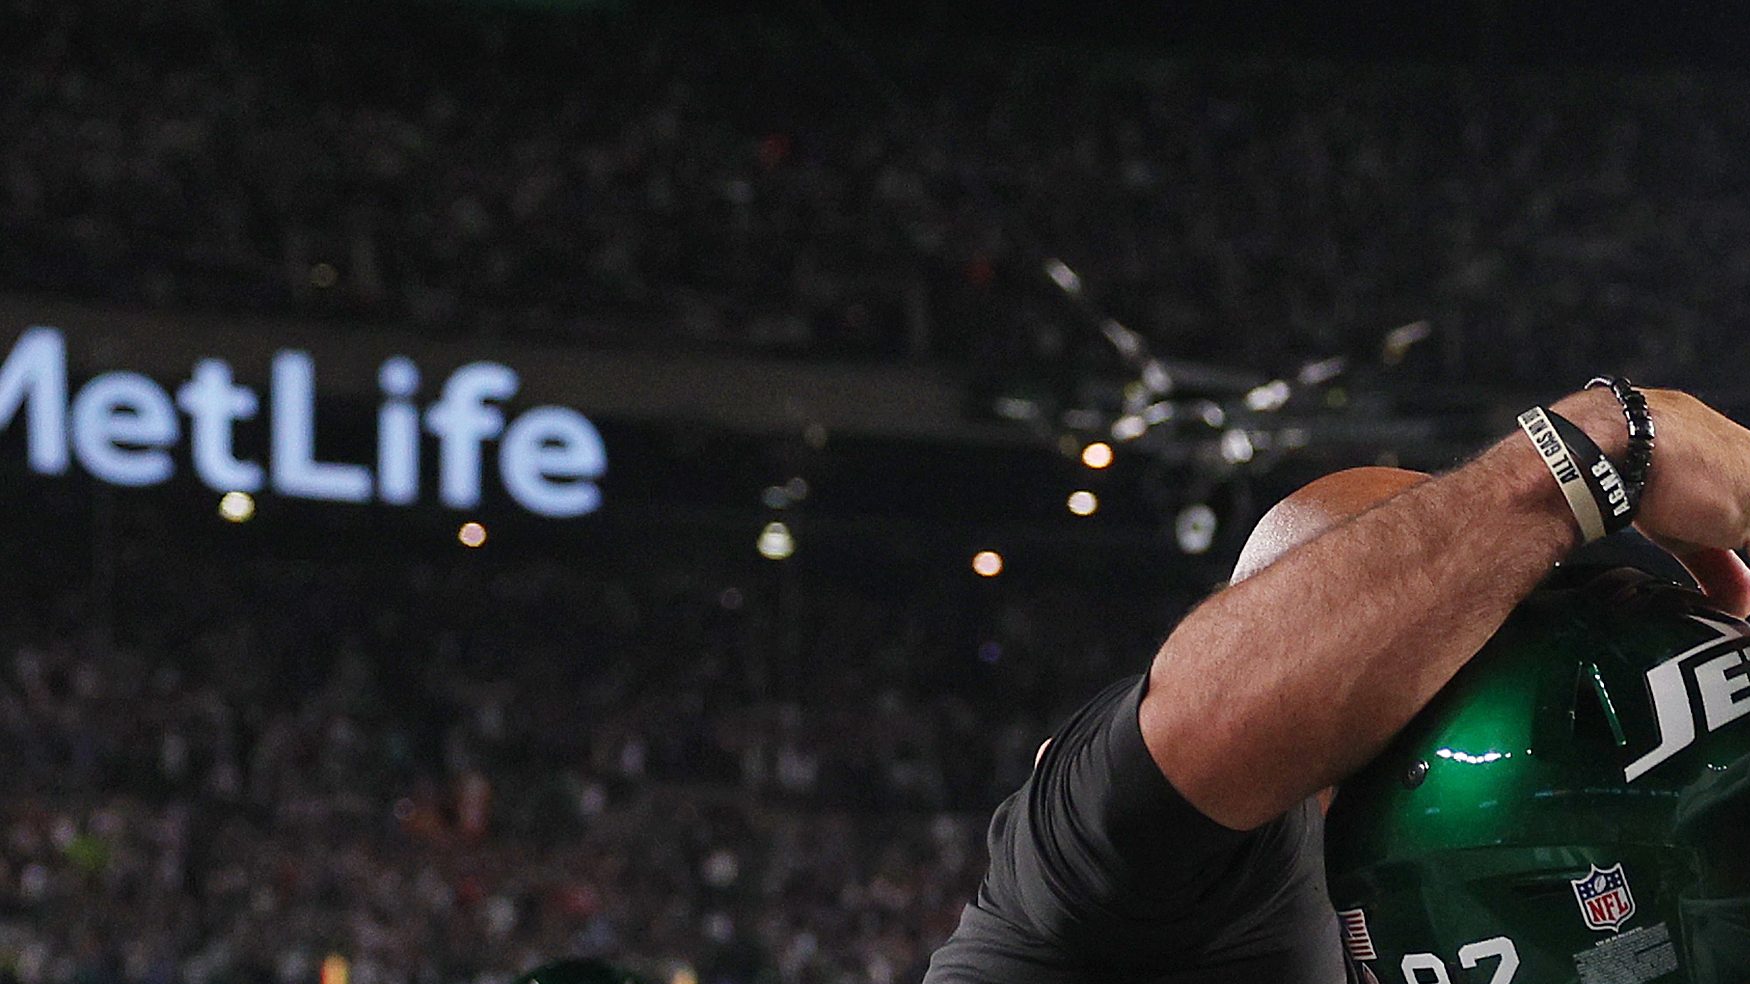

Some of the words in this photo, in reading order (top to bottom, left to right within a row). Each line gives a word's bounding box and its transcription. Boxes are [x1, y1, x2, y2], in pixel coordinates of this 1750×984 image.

[1536, 431, 1563, 458] GAS
[1552, 453, 1580, 485] ALL
[1586, 889, 1630, 923] NFL
